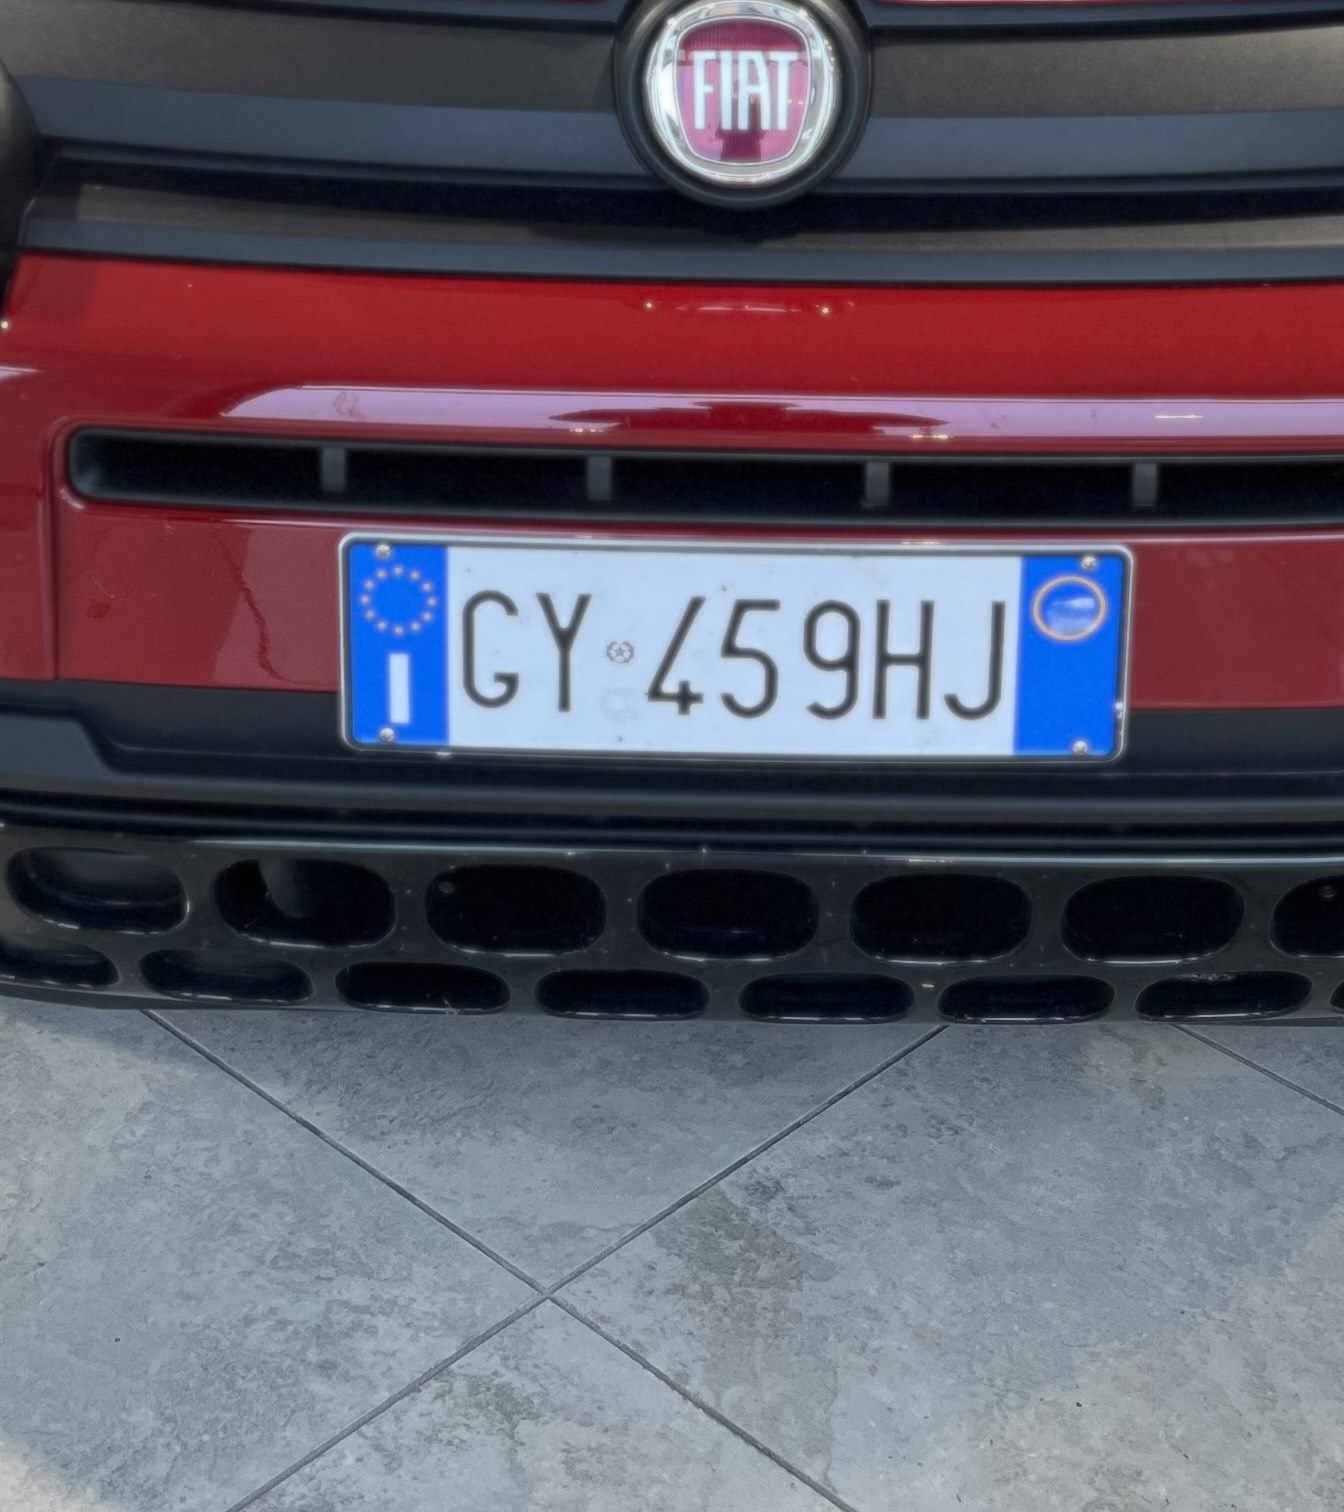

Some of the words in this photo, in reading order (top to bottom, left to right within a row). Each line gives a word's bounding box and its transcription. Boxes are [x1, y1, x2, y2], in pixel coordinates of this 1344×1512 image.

[692, 50, 799, 131] FIAT
[460, 590, 592, 713] GY
[645, 596, 1007, 720] 459HJ
